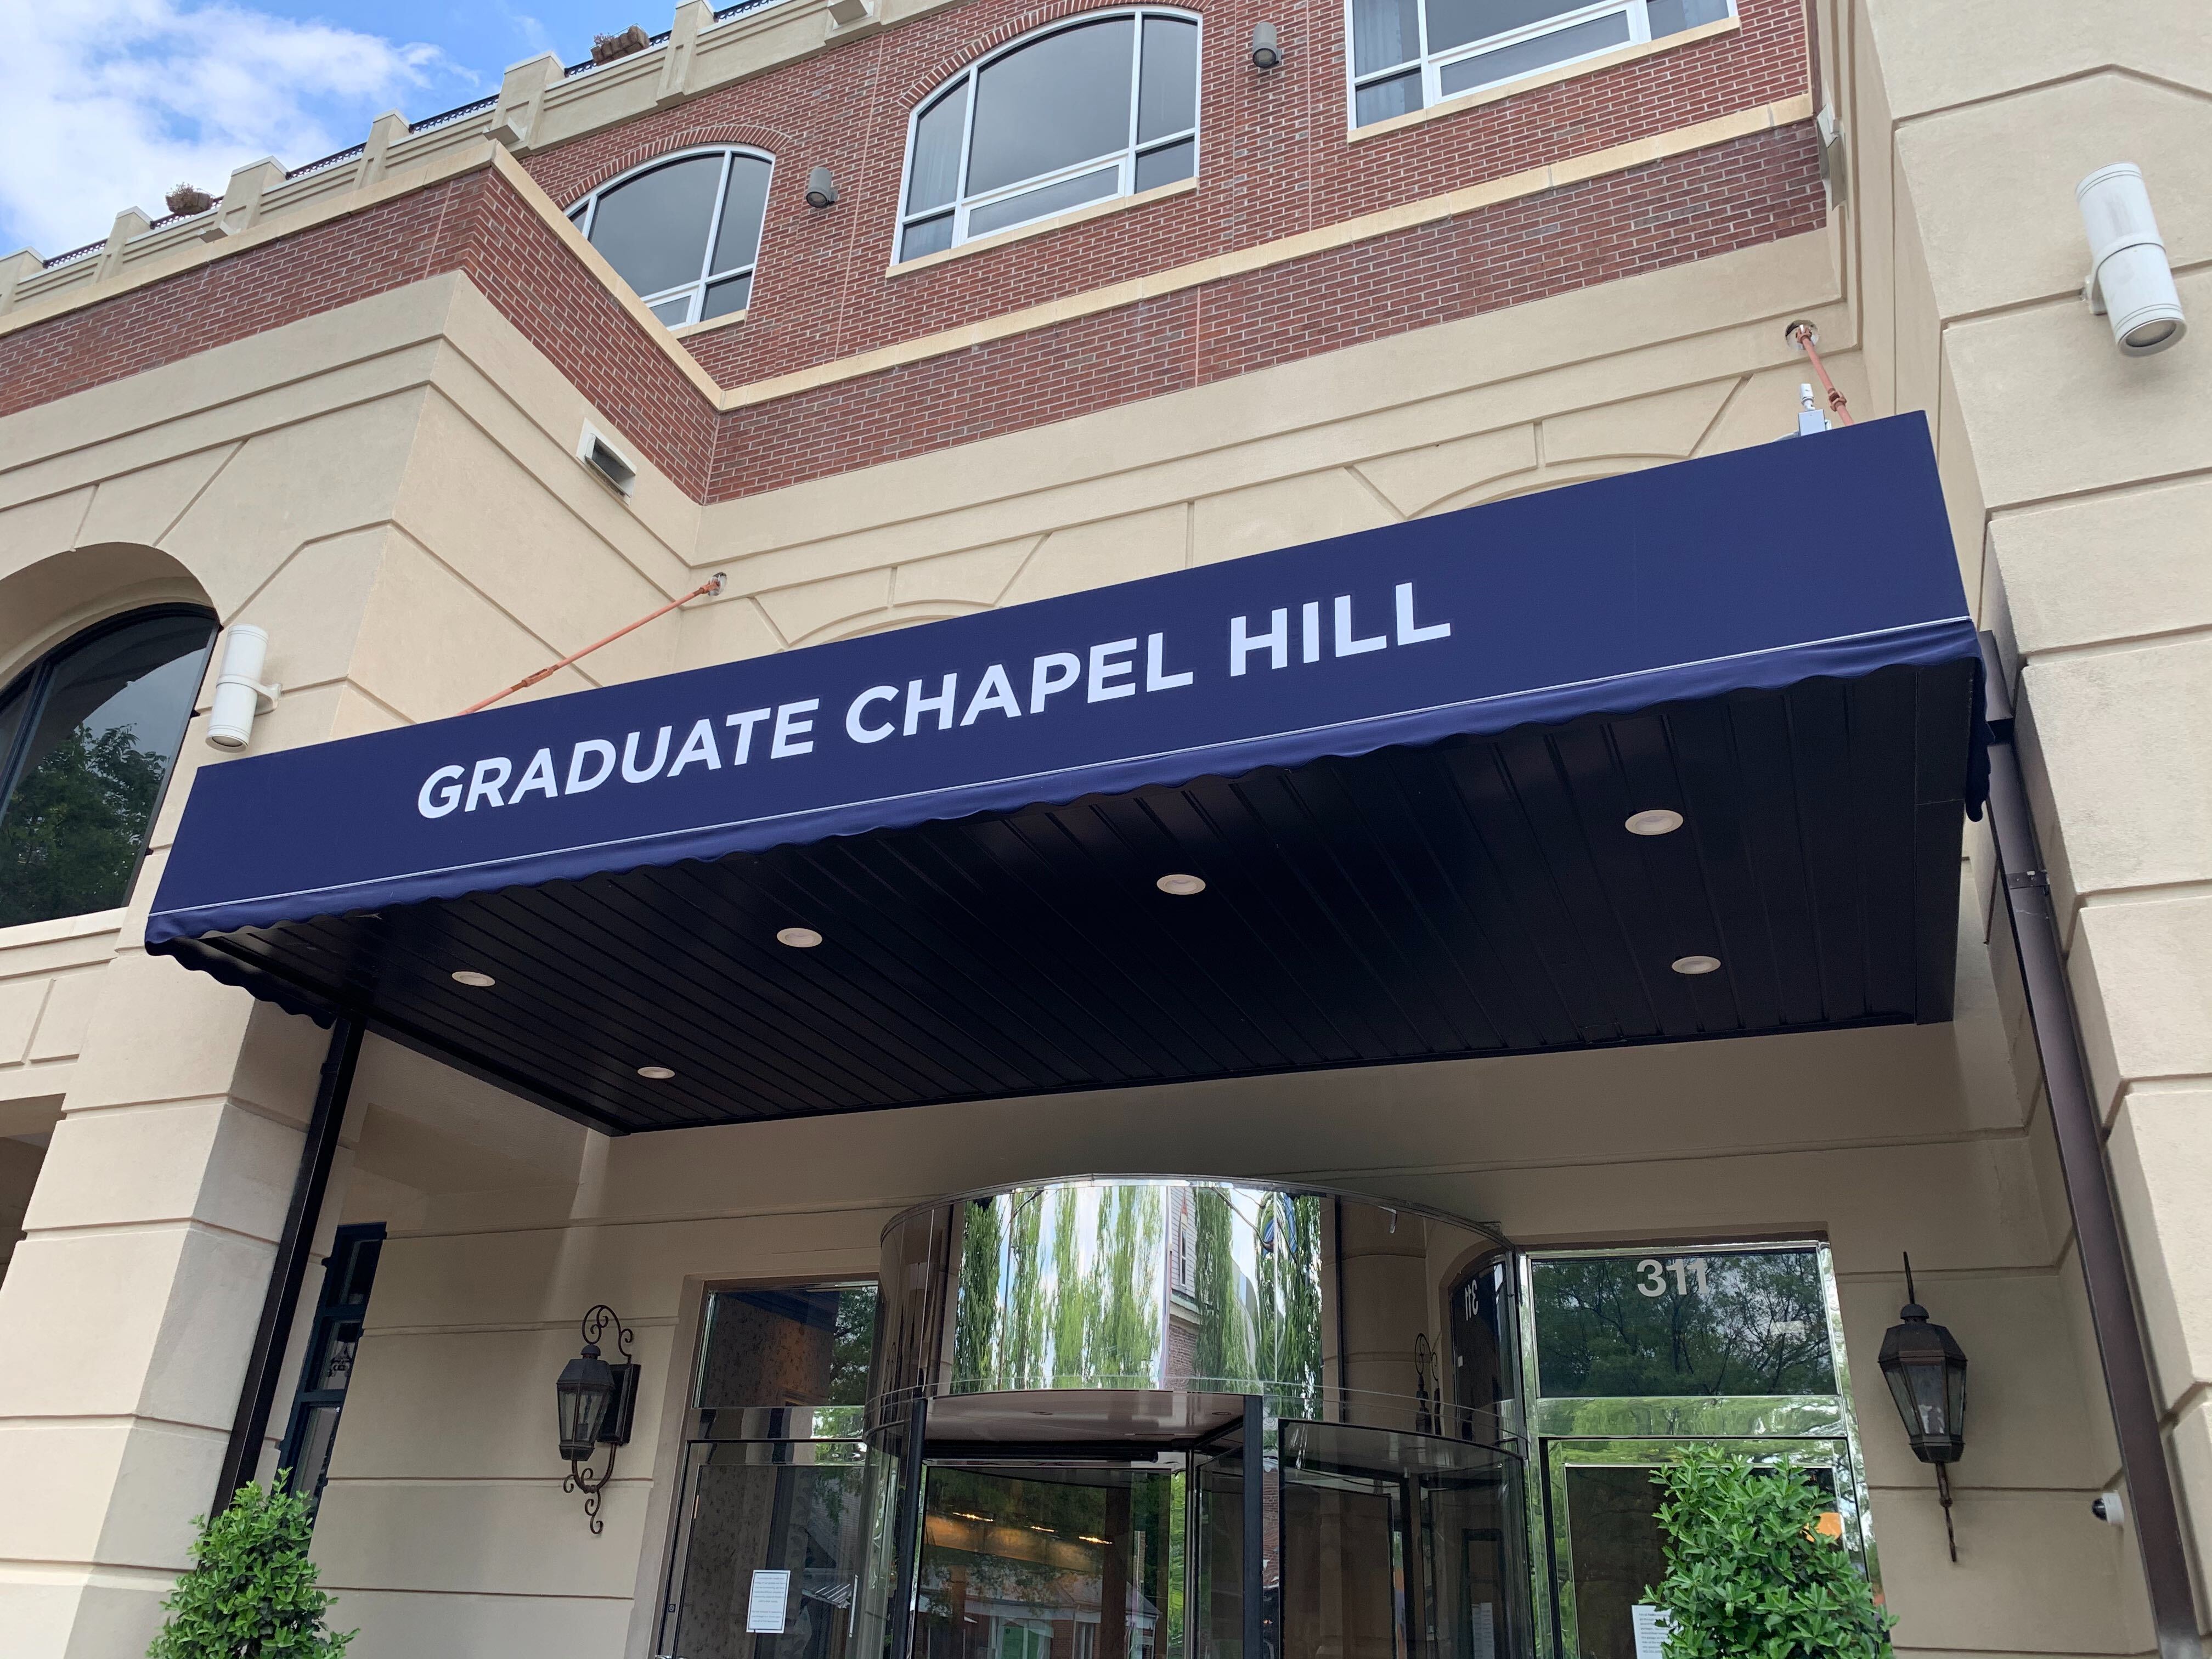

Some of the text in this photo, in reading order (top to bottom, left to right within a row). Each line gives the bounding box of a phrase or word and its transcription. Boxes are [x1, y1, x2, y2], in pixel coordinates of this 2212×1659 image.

[417, 582, 1451, 819] GRADUATE CHAPEL HILL
[1637, 1257, 1708, 1297] 311
